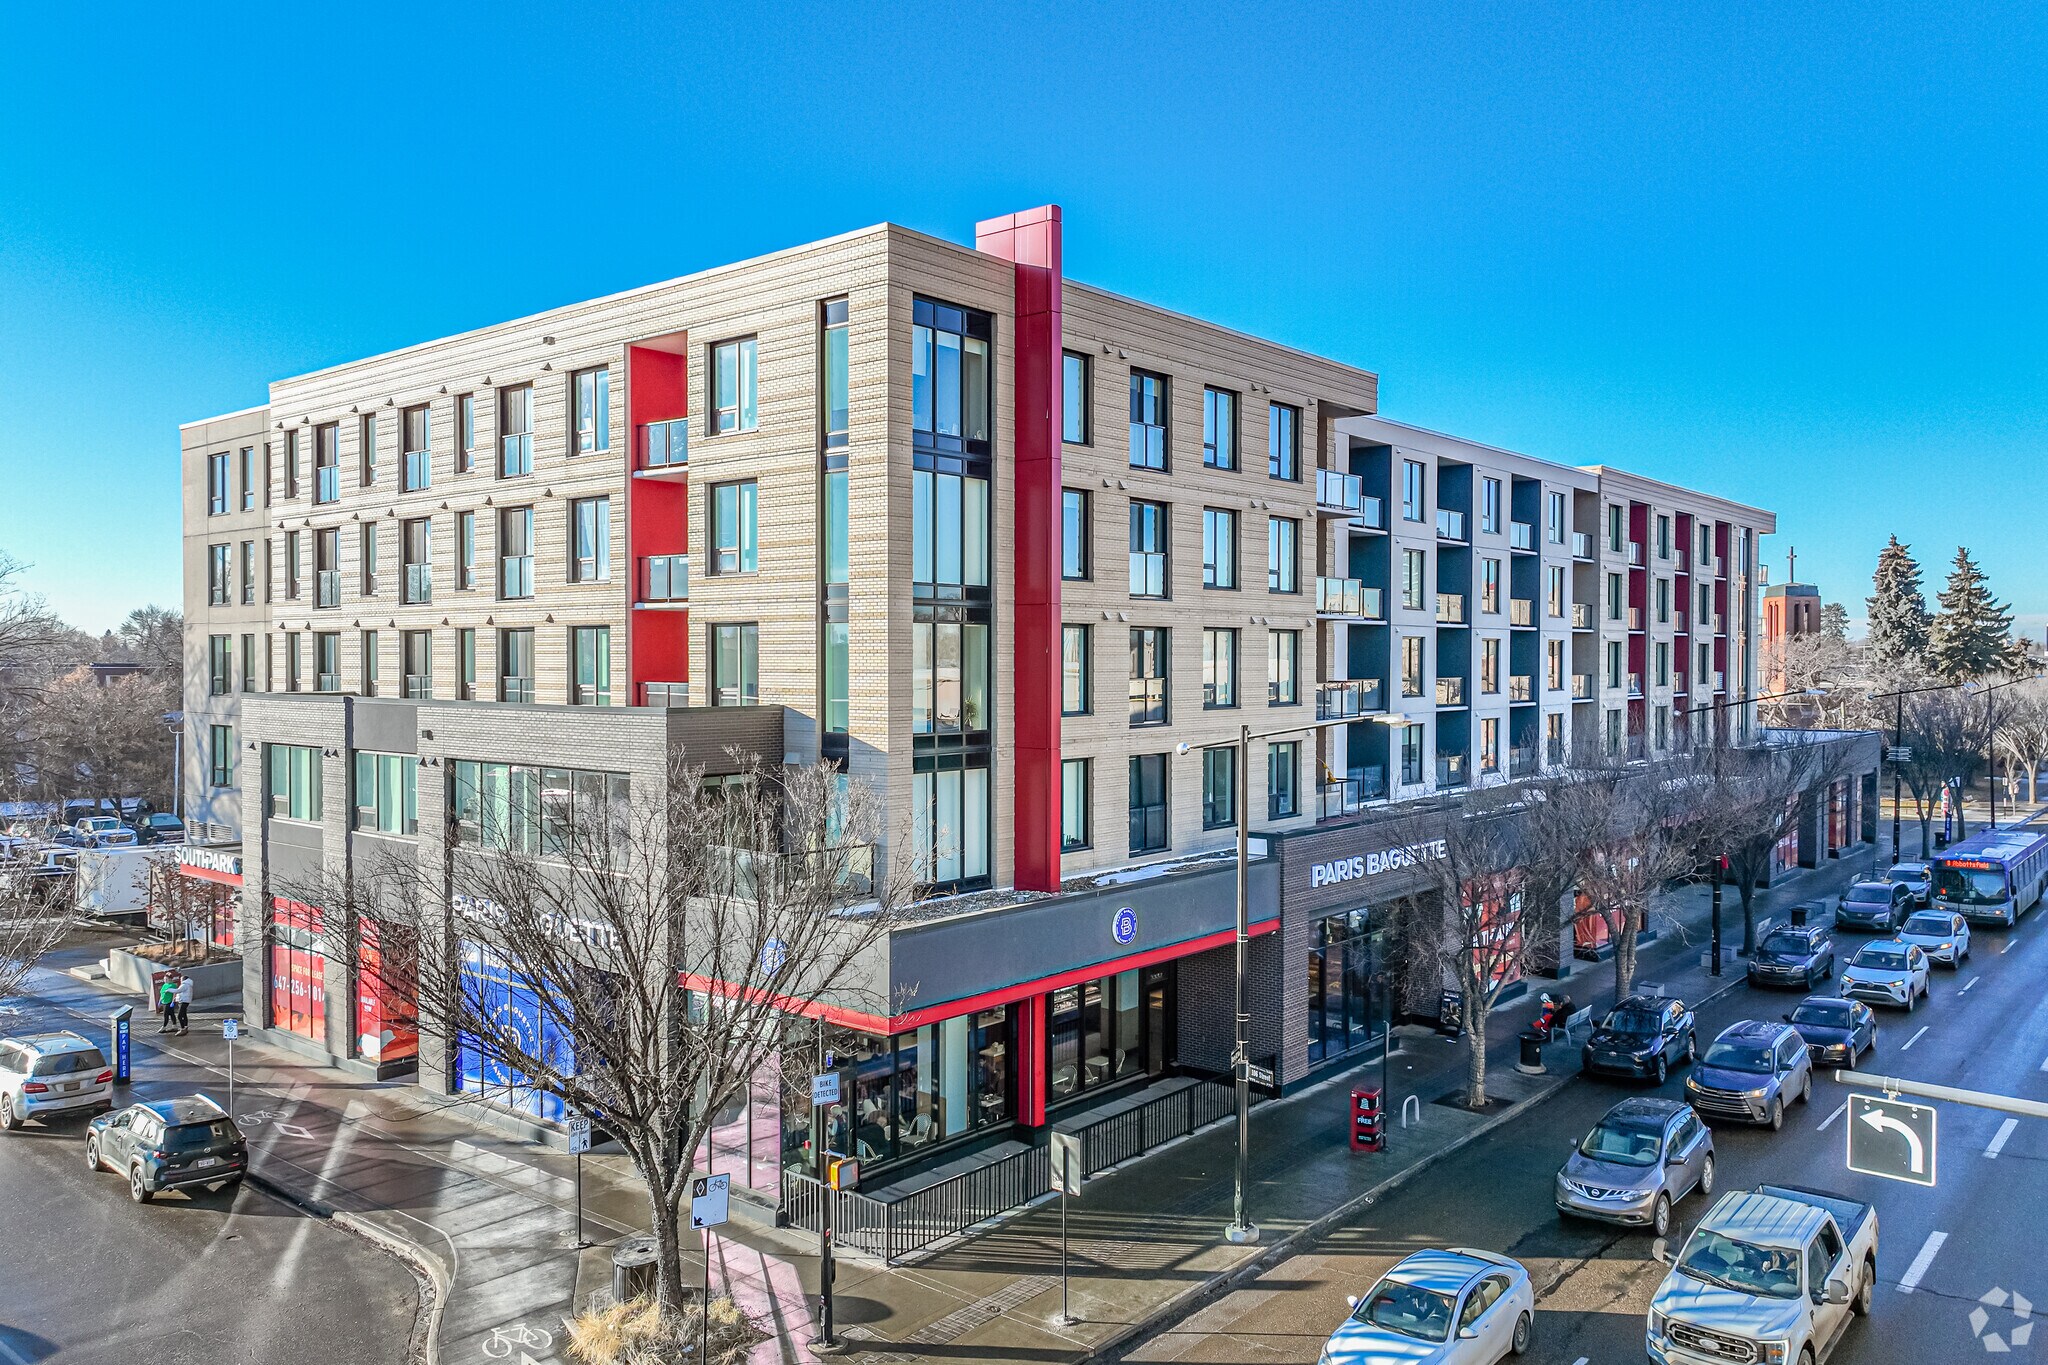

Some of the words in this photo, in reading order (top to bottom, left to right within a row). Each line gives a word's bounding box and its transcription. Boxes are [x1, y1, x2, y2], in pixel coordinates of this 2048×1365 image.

[174, 845, 236, 875] SOUTHPARK
[1311, 856, 1364, 888] PARIS
[1366, 839, 1447, 875] BAGUETTE
[291, 963, 303, 974] SPACE
[302, 966, 311, 977] FOR
[312, 969, 324, 981] LEASE
[819, 1079, 832, 1088] BIKE
[814, 1089, 837, 1099] DETECTED
[570, 1119, 589, 1132] KEEP
